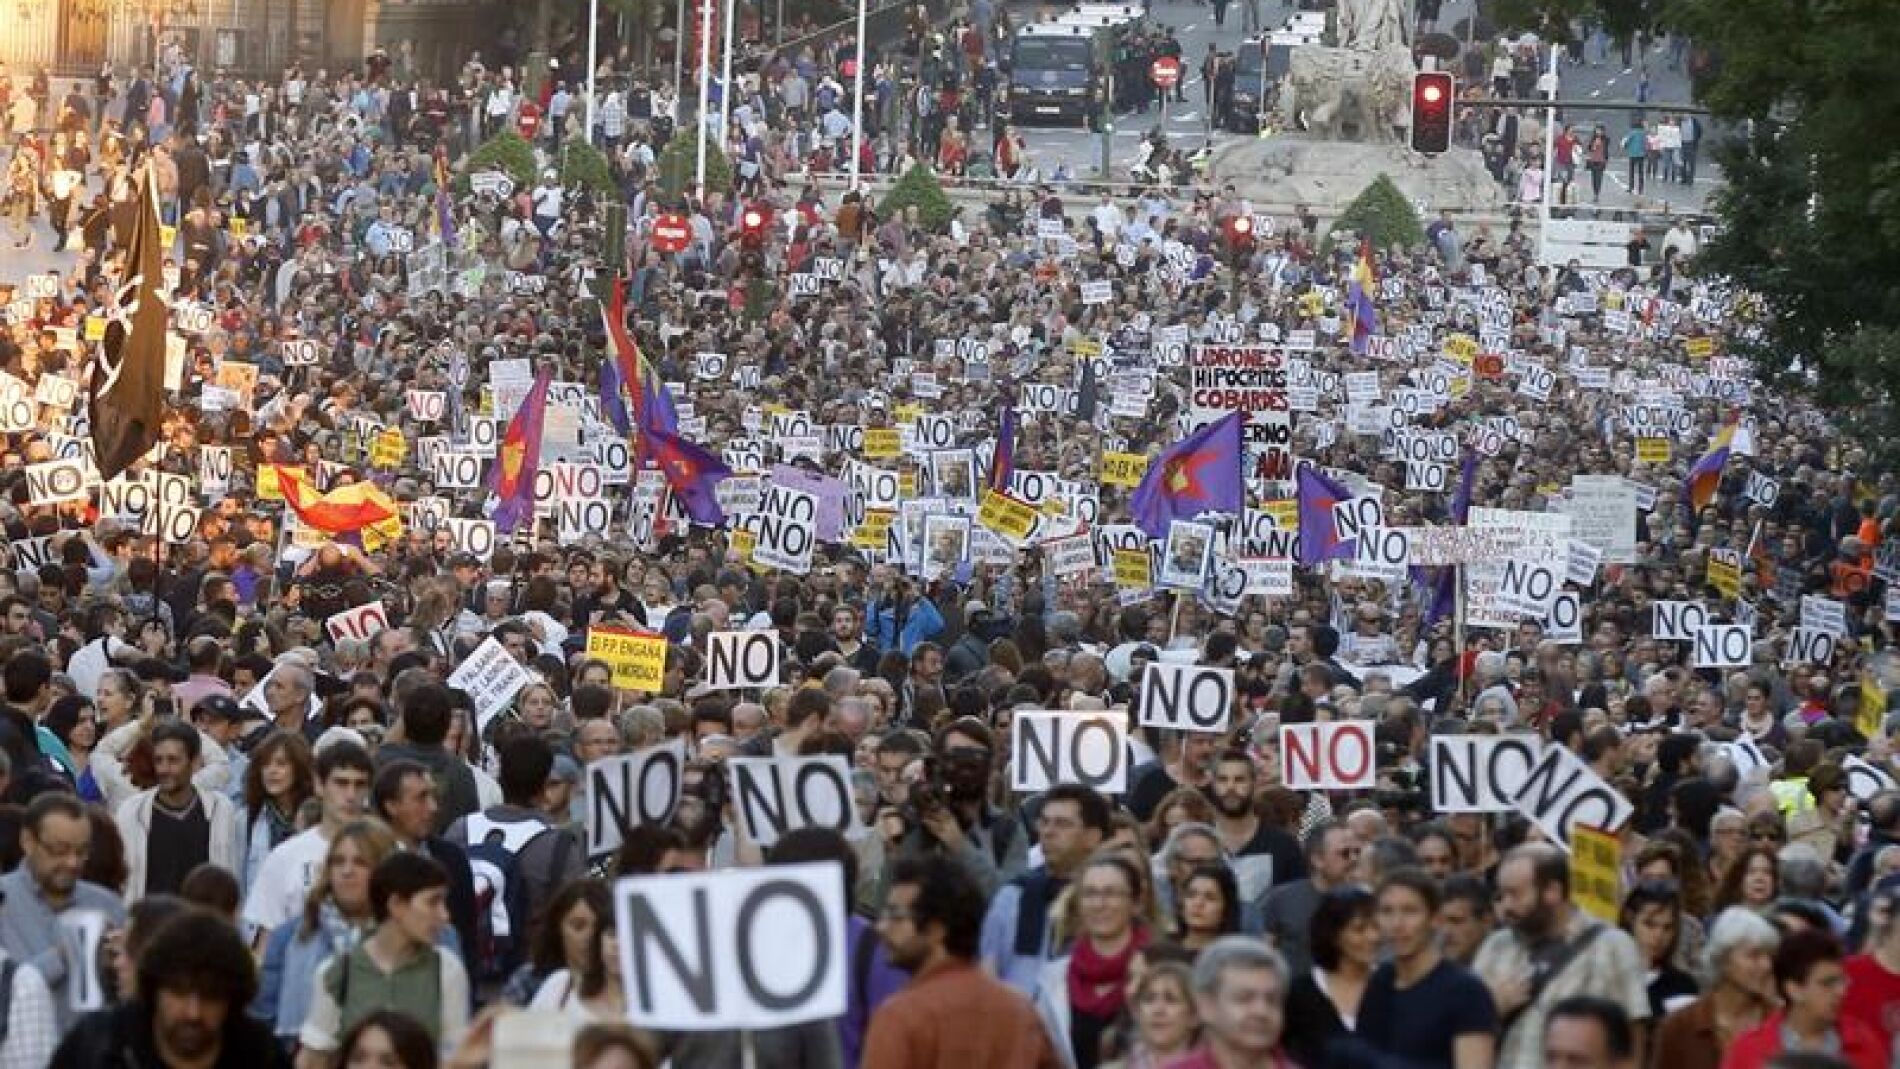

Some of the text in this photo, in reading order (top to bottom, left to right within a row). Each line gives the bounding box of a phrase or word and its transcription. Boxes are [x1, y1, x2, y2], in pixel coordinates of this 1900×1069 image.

[817, 261, 841, 278] NO
[285, 342, 314, 363] NO
[963, 341, 988, 359] NO
[1157, 344, 1181, 363] NO
[1193, 349, 1282, 366] LADRONES
[1420, 372, 1446, 394] NO
[1528, 366, 1554, 388] NO
[411, 394, 442, 418] NO
[1023, 386, 1056, 409] NO
[1195, 390, 1288, 411] COBARDES
[1623, 406, 1648, 425] NO
[918, 420, 952, 448] NO
[1396, 438, 1428, 461] NO
[1430, 437, 1456, 459] NO
[205, 449, 229, 480] NO
[439, 456, 477, 485] NO
[1408, 464, 1442, 488] NO
[29, 466, 80, 499] NO
[557, 467, 599, 498] NO
[1748, 478, 1778, 505] NO
[105, 484, 148, 514] NO
[562, 501, 609, 532] NO
[1336, 499, 1381, 538] NO
[1359, 530, 1407, 563] NO
[1501, 560, 1551, 600] NO
[1658, 603, 1704, 637] NO
[712, 634, 775, 685] NO
[1698, 628, 1748, 661] NO
[1789, 630, 1832, 662] NO
[1144, 667, 1227, 725] NO
[1018, 716, 1120, 785] NO
[1285, 726, 1370, 784] NO
[1436, 740, 1535, 806] NO
[594, 751, 678, 845] NO
[736, 762, 849, 839] NO
[1514, 750, 1616, 842] NO
[628, 880, 830, 1014] NO
